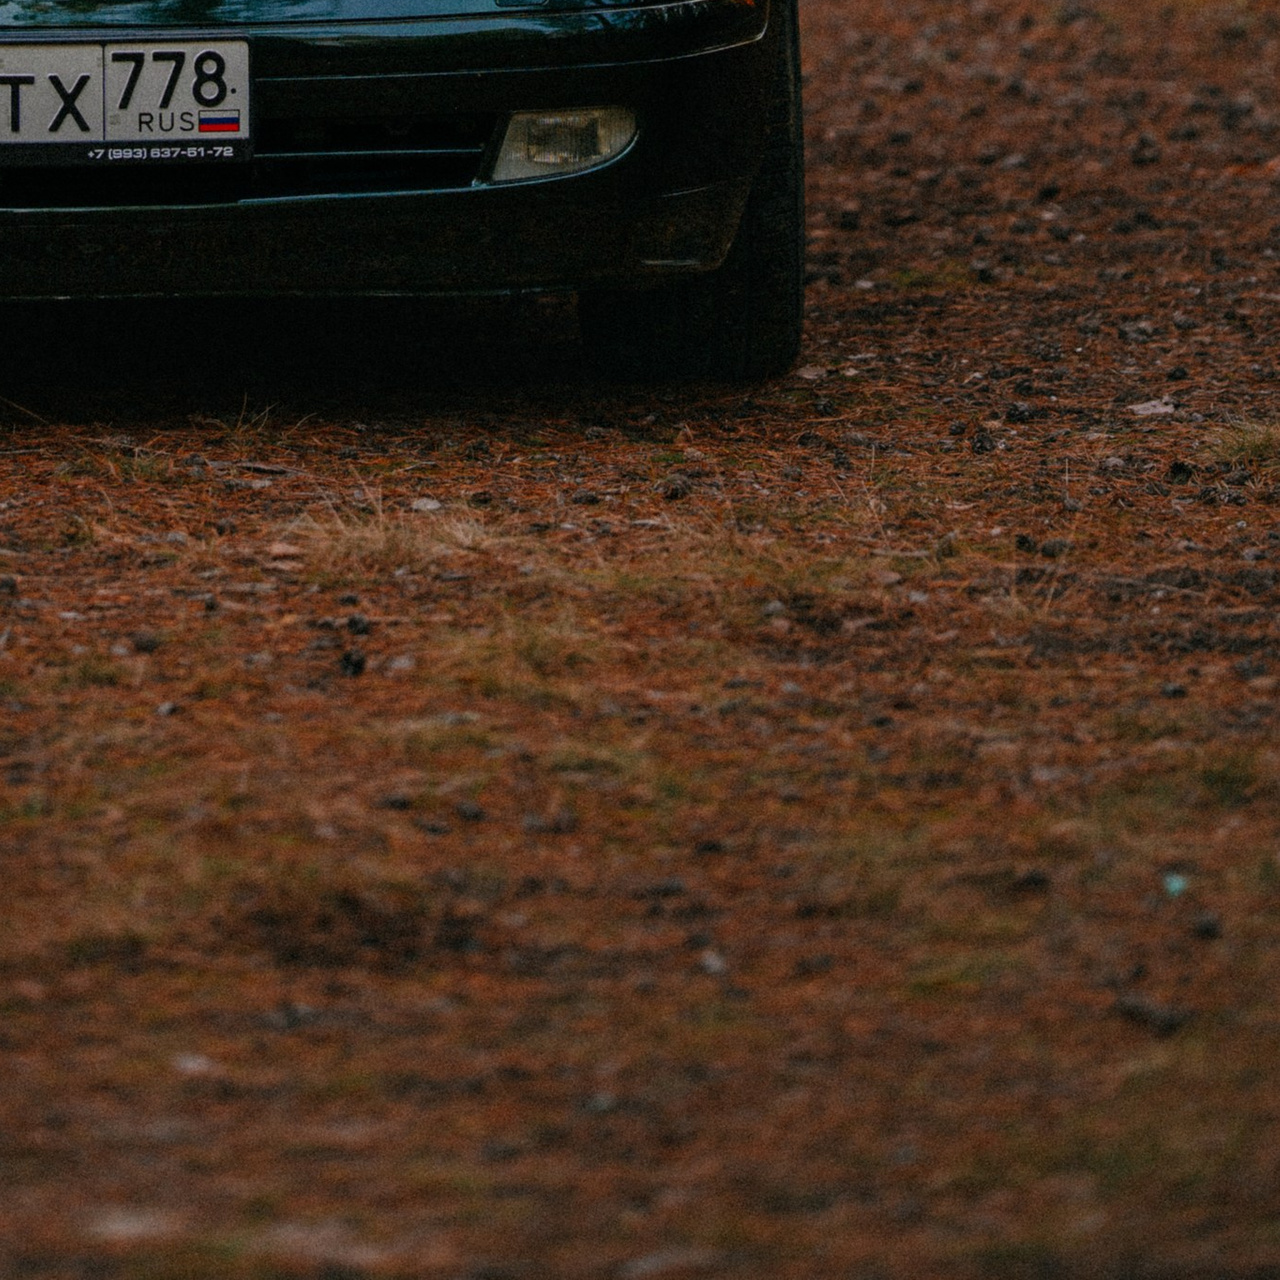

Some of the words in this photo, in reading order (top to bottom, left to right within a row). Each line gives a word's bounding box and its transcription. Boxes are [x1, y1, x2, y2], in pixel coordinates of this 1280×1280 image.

[111, 50, 227, 109] 778
[138, 112, 195, 132] RUS
[87, 149, 105, 159] +7
[108, 148, 147, 160] (993)
